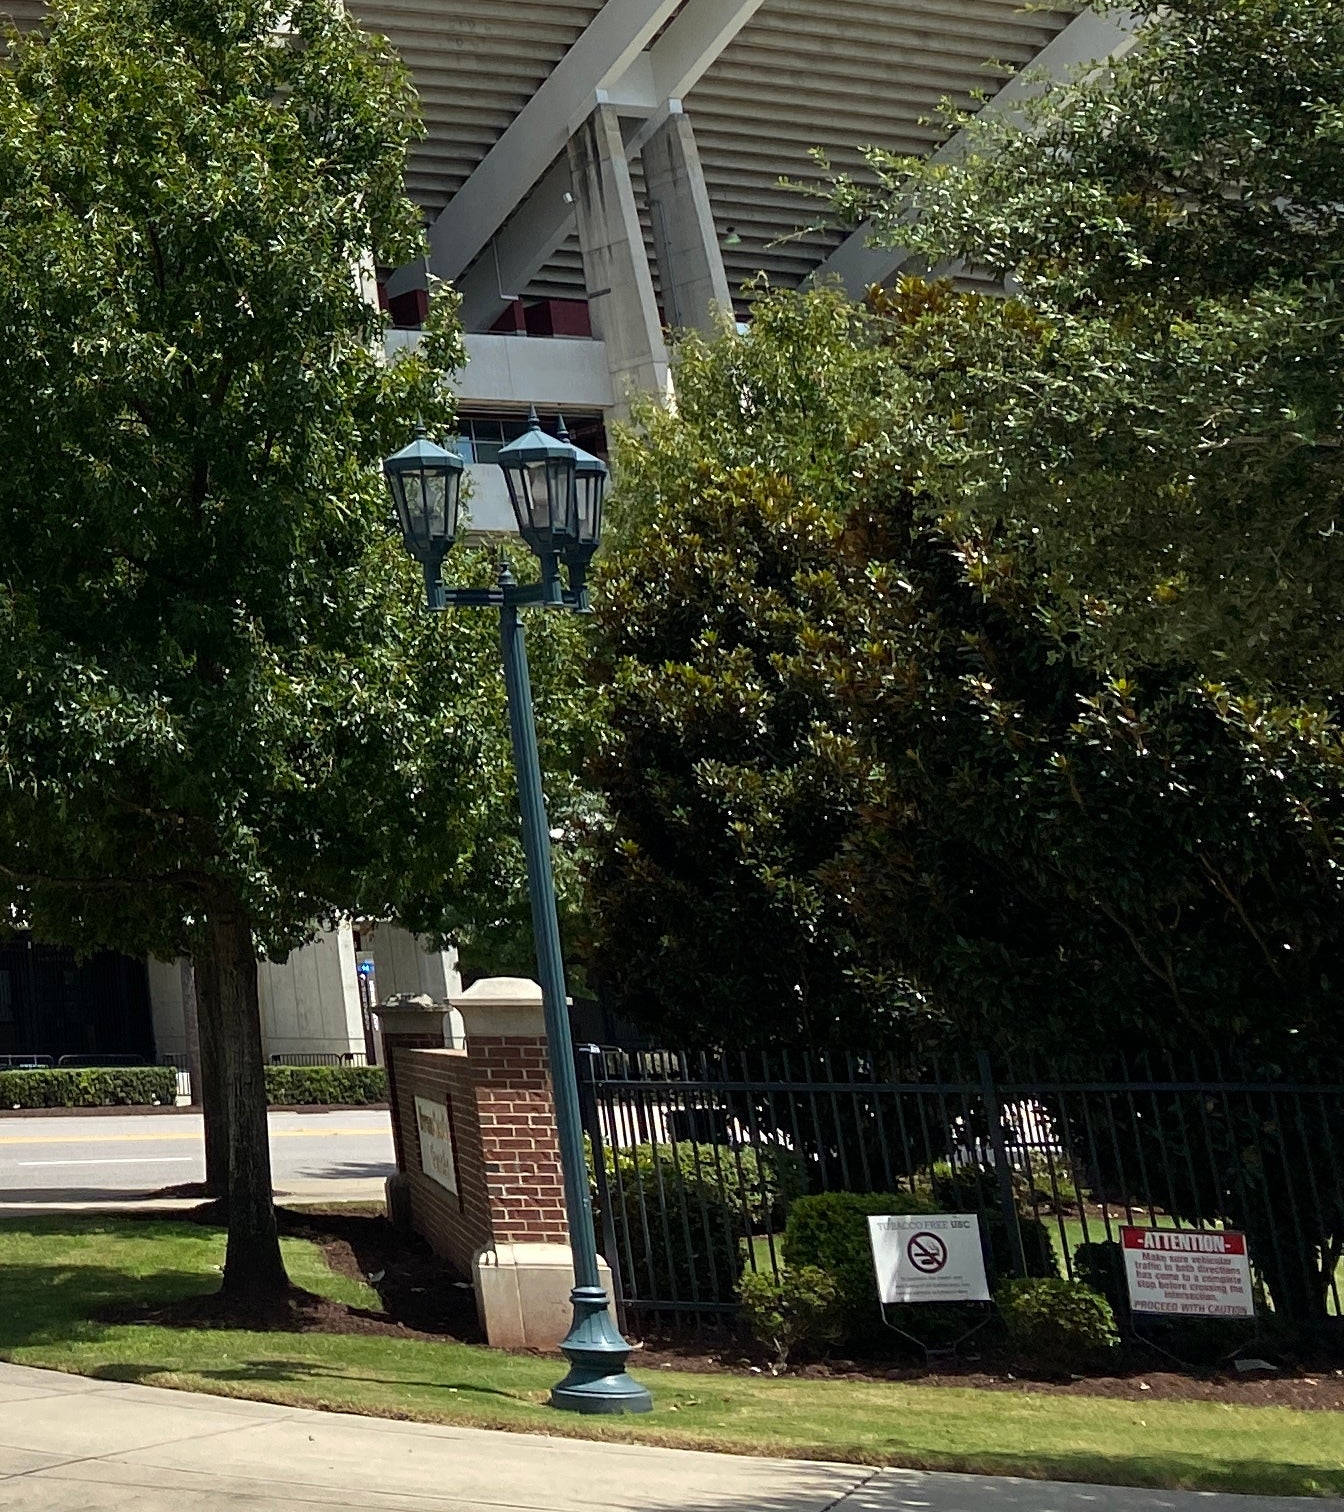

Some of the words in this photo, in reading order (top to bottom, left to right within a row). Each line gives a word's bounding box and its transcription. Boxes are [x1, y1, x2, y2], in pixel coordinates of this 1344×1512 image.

[924, 1220, 949, 1229] FREE
[1142, 1252, 1167, 1262] Make
[1170, 1255, 1189, 1263] sure
[1134, 1261, 1161, 1271] traffic
[1165, 1262, 1173, 1271] in
[1176, 1263, 1195, 1273] both
[1198, 1265, 1240, 1275] directions
[1136, 1270, 1152, 1279] has
[1155, 1272, 1179, 1281] come
[1182, 1273, 1191, 1282] to
[1202, 1275, 1242, 1285] complete
[1137, 1279, 1157, 1290] stop
[1159, 1281, 1187, 1291] before
[1190, 1283, 1227, 1295] crossing
[1230, 1284, 1243, 1294] the
[1134, 1300, 1178, 1311] PROCEED
[1181, 1303, 1205, 1313] WITH
[1208, 1304, 1248, 1315] CAUTION
